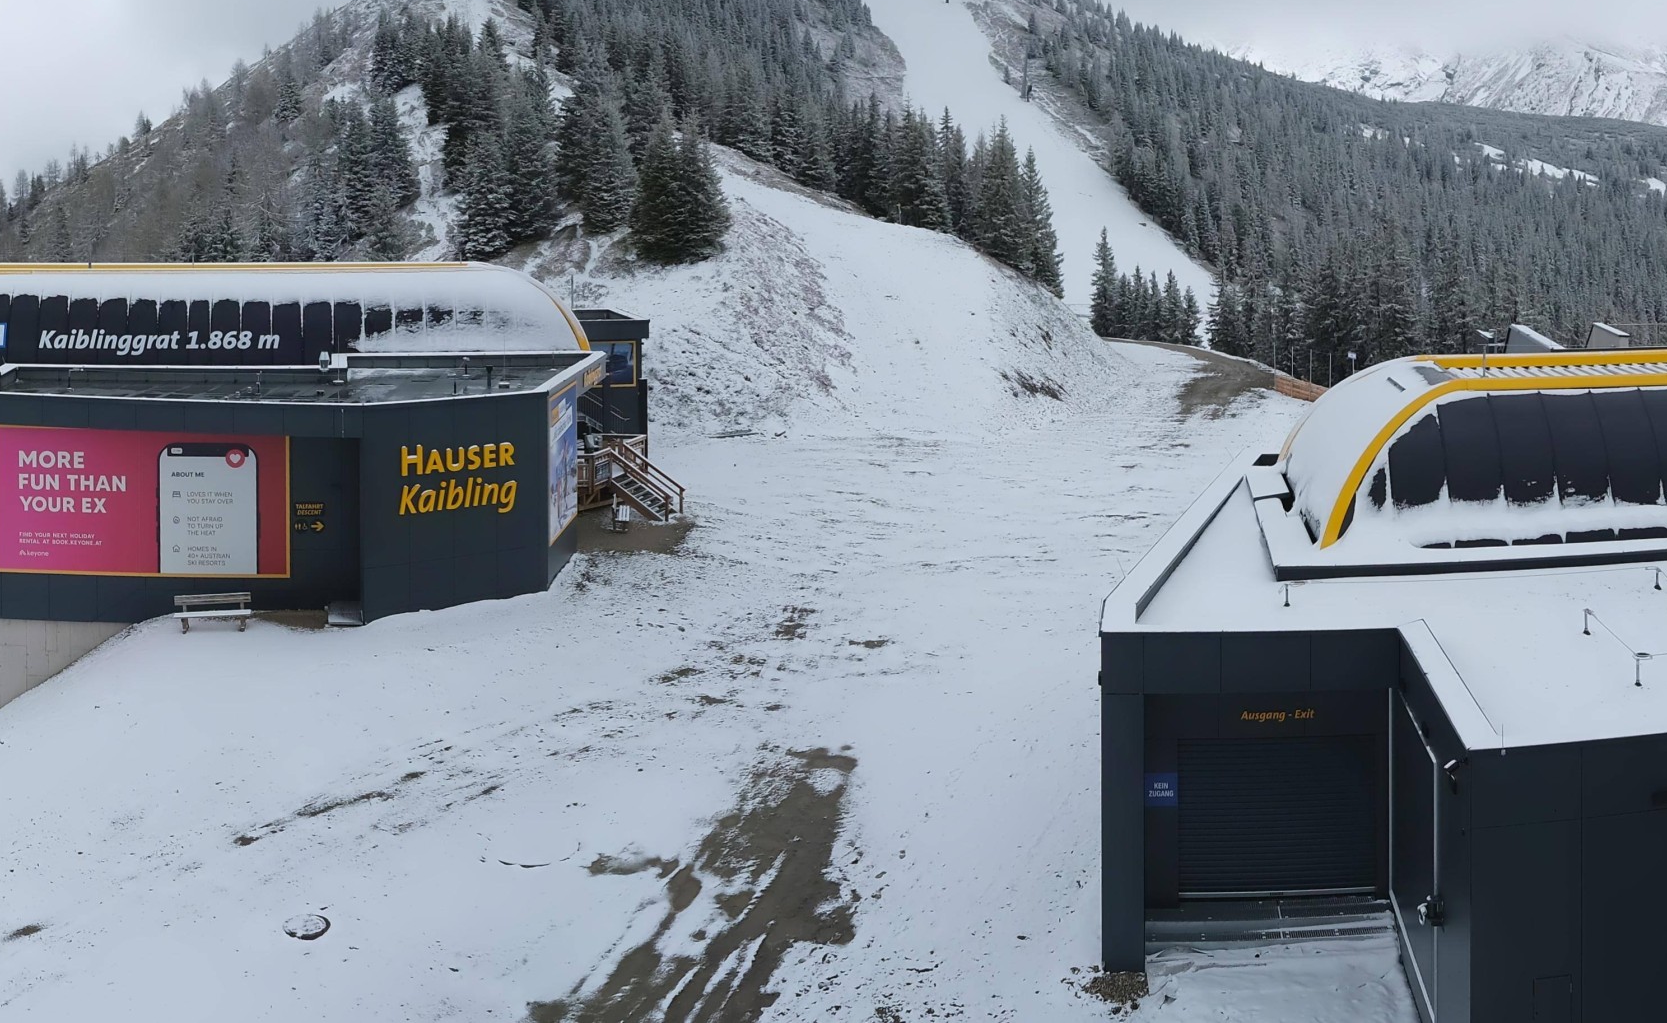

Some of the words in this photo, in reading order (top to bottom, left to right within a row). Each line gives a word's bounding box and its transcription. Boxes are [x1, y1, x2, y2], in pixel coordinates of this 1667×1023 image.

[39, 329, 180, 356] Kaiblinggrat
[186, 330, 252, 350] 1.868
[257, 334, 280, 350] m
[18, 450, 85, 469] MORE
[401, 441, 515, 477] HAUSER
[18, 473, 60, 491] FUN
[66, 474, 127, 493] THAN
[19, 495, 75, 513] YOUR
[81, 497, 107, 514] EX
[398, 476, 518, 515] Kaibling
[1241, 710, 1286, 723] Ausgang
[1294, 708, 1315, 719] Exit
